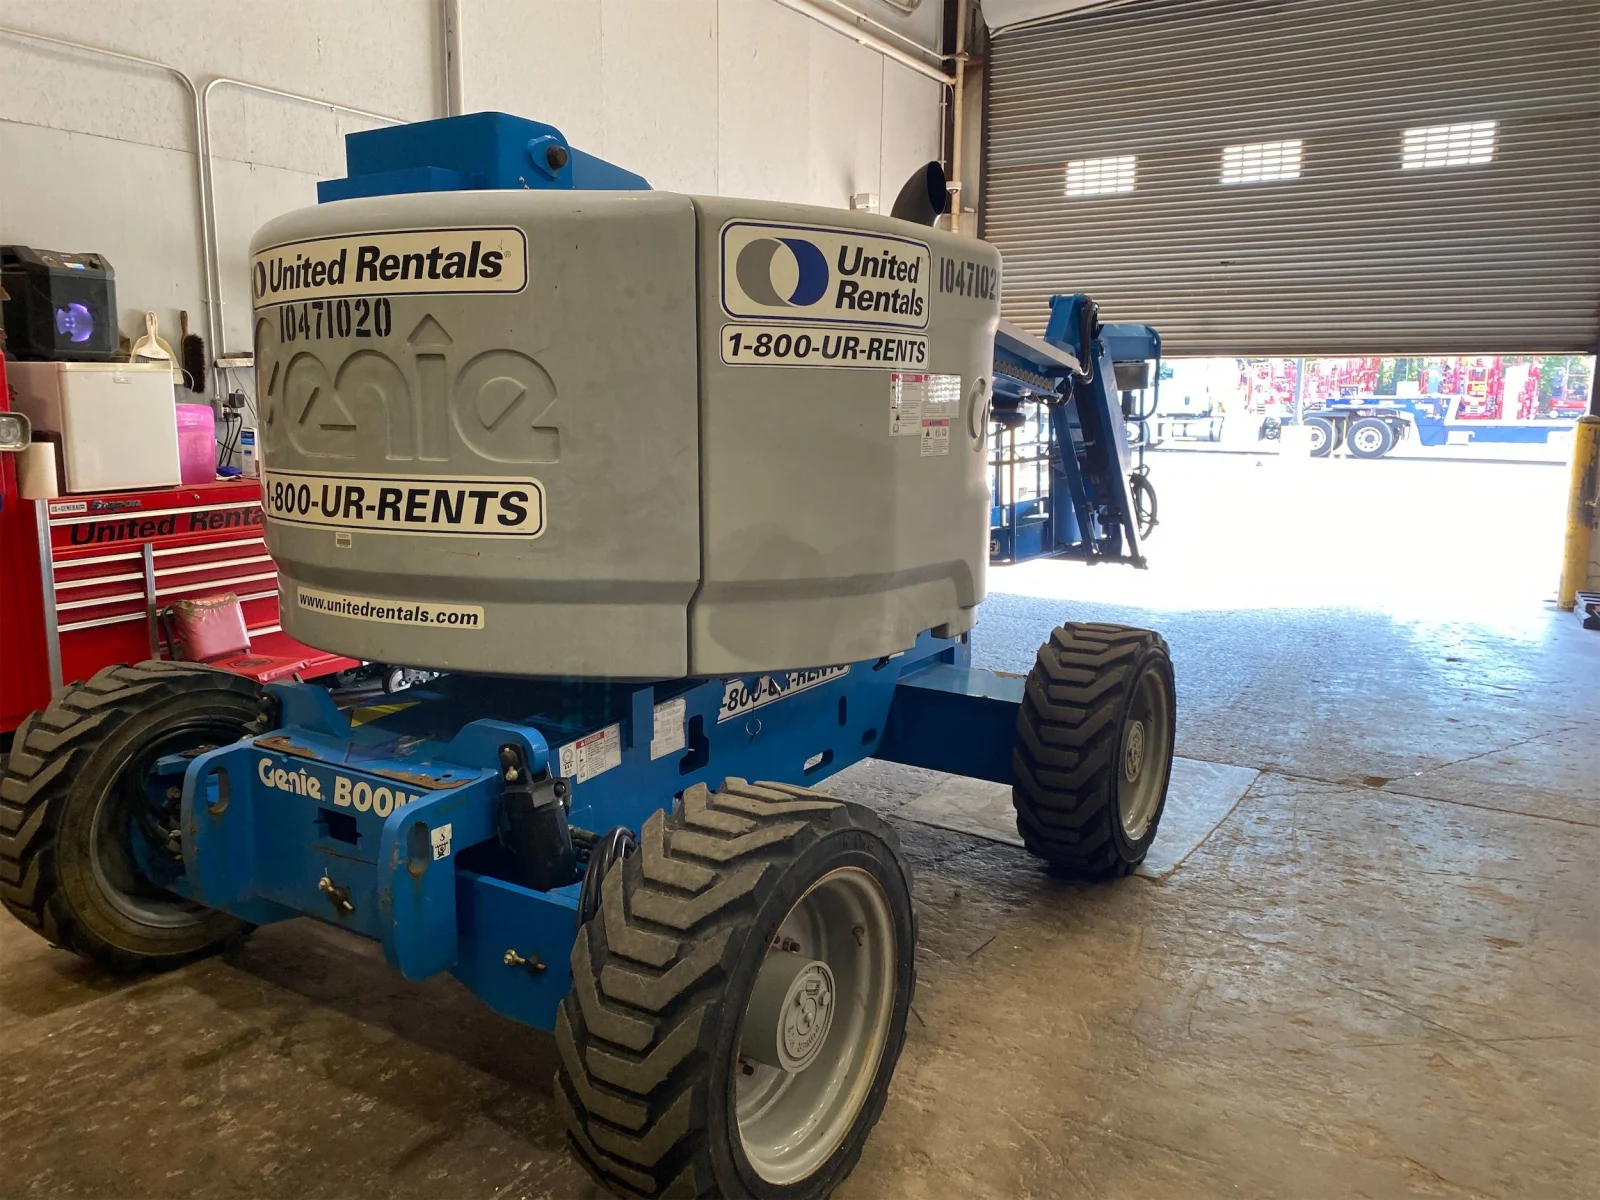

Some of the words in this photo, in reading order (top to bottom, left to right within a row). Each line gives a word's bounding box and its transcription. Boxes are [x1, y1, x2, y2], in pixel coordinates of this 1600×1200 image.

[269, 248, 347, 293] United
[355, 240, 503, 283] Rentals
[837, 245, 921, 284] United
[939, 256, 998, 301] 1047102
[834, 279, 924, 317] Rentals
[278, 297, 392, 343] 10471020
[727, 332, 926, 364] 1-800-UR-RENTS
[266, 480, 529, 527] 1-800-UR-RENTS
[70, 513, 176, 546] United
[299, 592, 479, 626] www.unitedrentals.com
[258, 757, 322, 801] Genie
